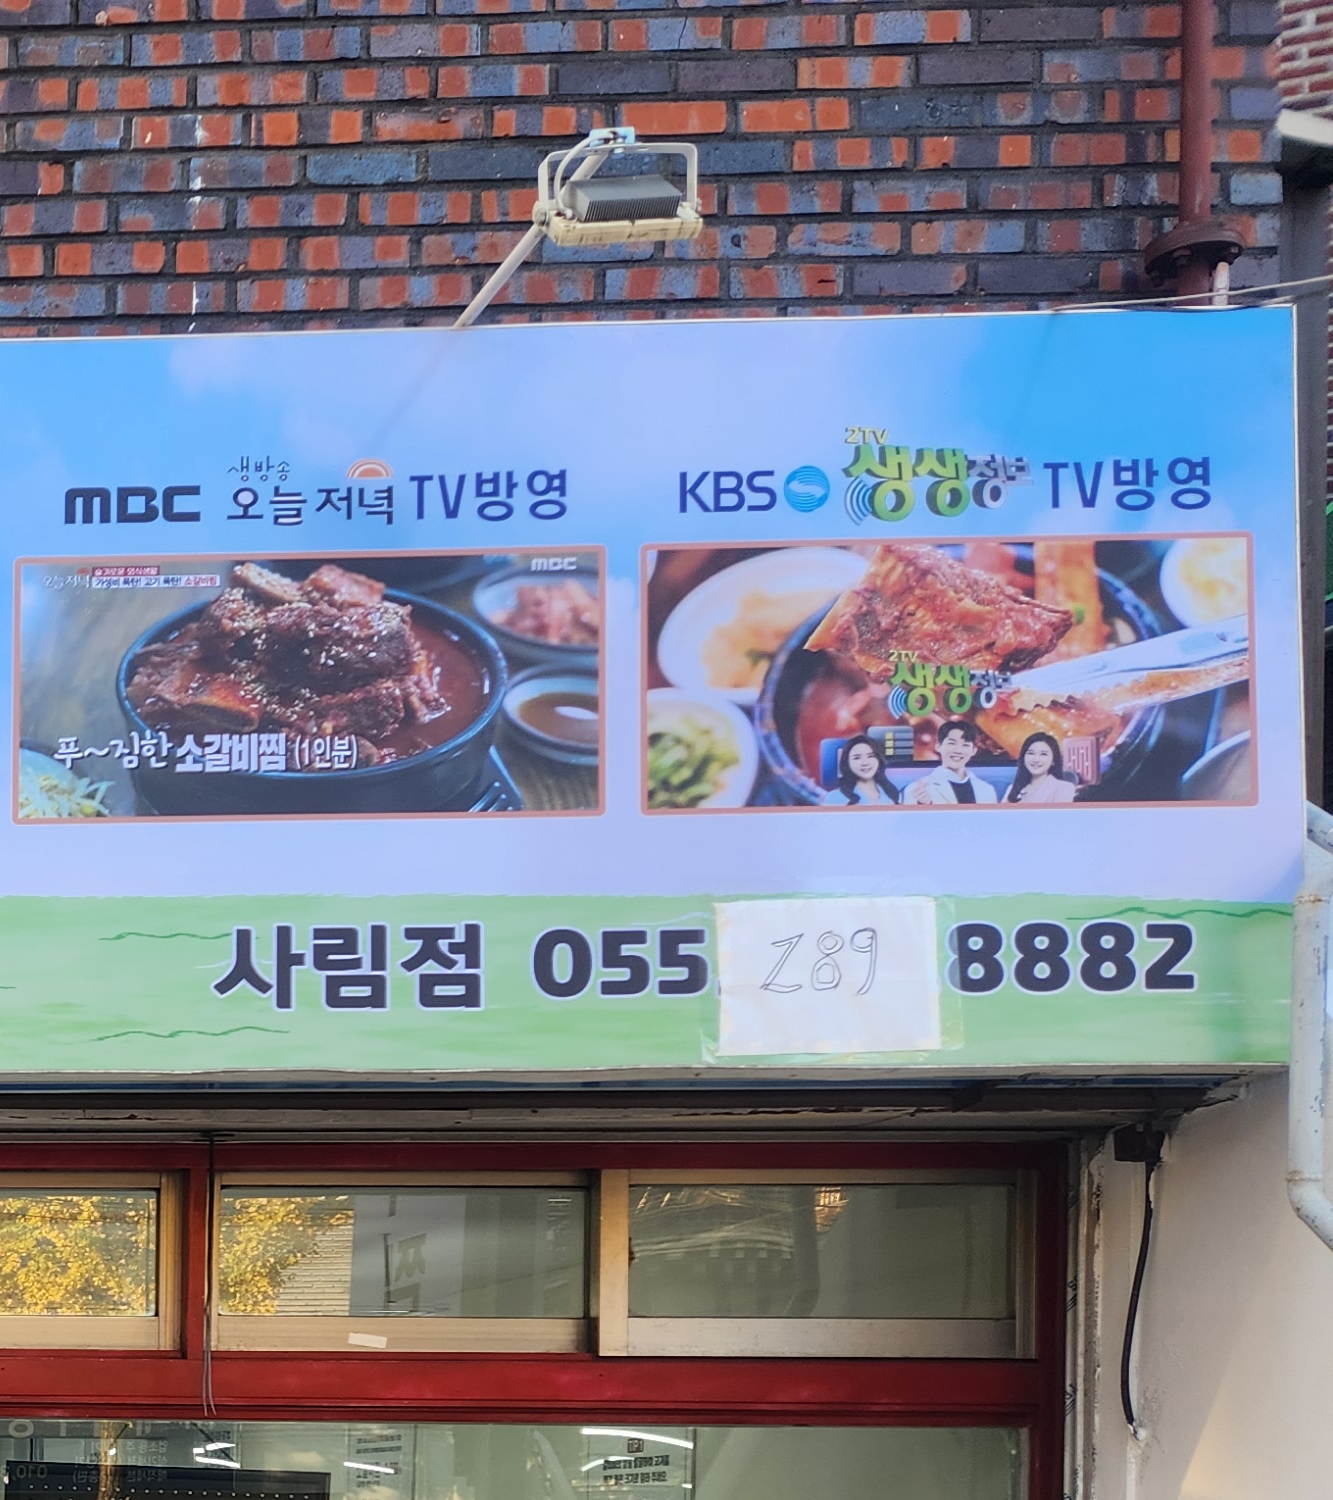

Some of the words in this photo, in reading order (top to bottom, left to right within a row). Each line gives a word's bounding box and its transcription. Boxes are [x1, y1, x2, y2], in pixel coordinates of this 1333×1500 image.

[844, 425, 891, 445] 2TV
[226, 455, 291, 483] 생방송
[64, 484, 201, 525] MBC
[409, 468, 569, 522] TV방영
[678, 469, 778, 514] KBS
[841, 444, 1035, 523] 생생정보
[1042, 456, 1213, 512] TV방영
[531, 556, 578, 572] MBC
[184, 575, 219, 588] 소갈비찜
[888, 649, 918, 662] 2TV
[174, 732, 287, 774] 소갈비찜
[293, 733, 360, 771] (1인분)
[211, 922, 485, 1012] 사림점
[945, 921, 1197, 994] 8882
